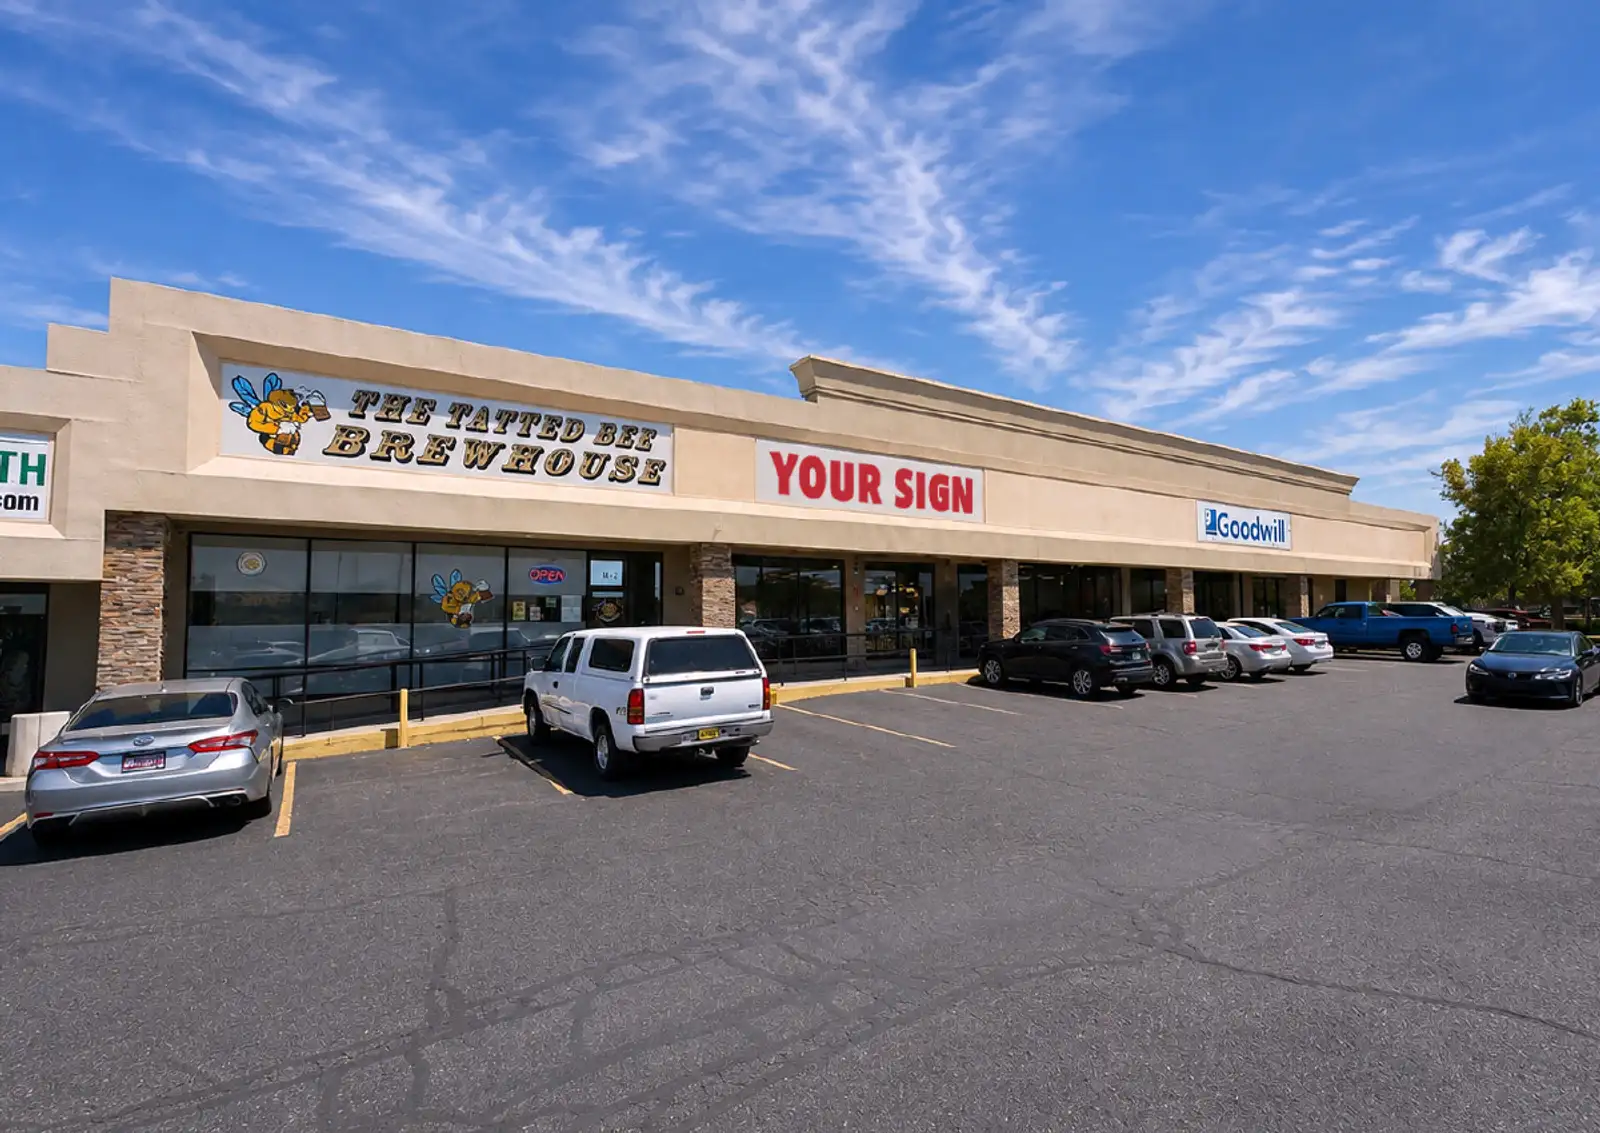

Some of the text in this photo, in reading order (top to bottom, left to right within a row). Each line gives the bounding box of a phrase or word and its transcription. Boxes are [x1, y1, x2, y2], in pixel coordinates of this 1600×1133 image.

[348, 389, 658, 452] THE TATTED BEE
[322, 424, 667, 486] BREWHOUSE
[0, 494, 39, 511] om
[769, 451, 974, 514] YOUR SIGN
[1217, 512, 1286, 543] Goodwill
[529, 569, 565, 582] OPEN
